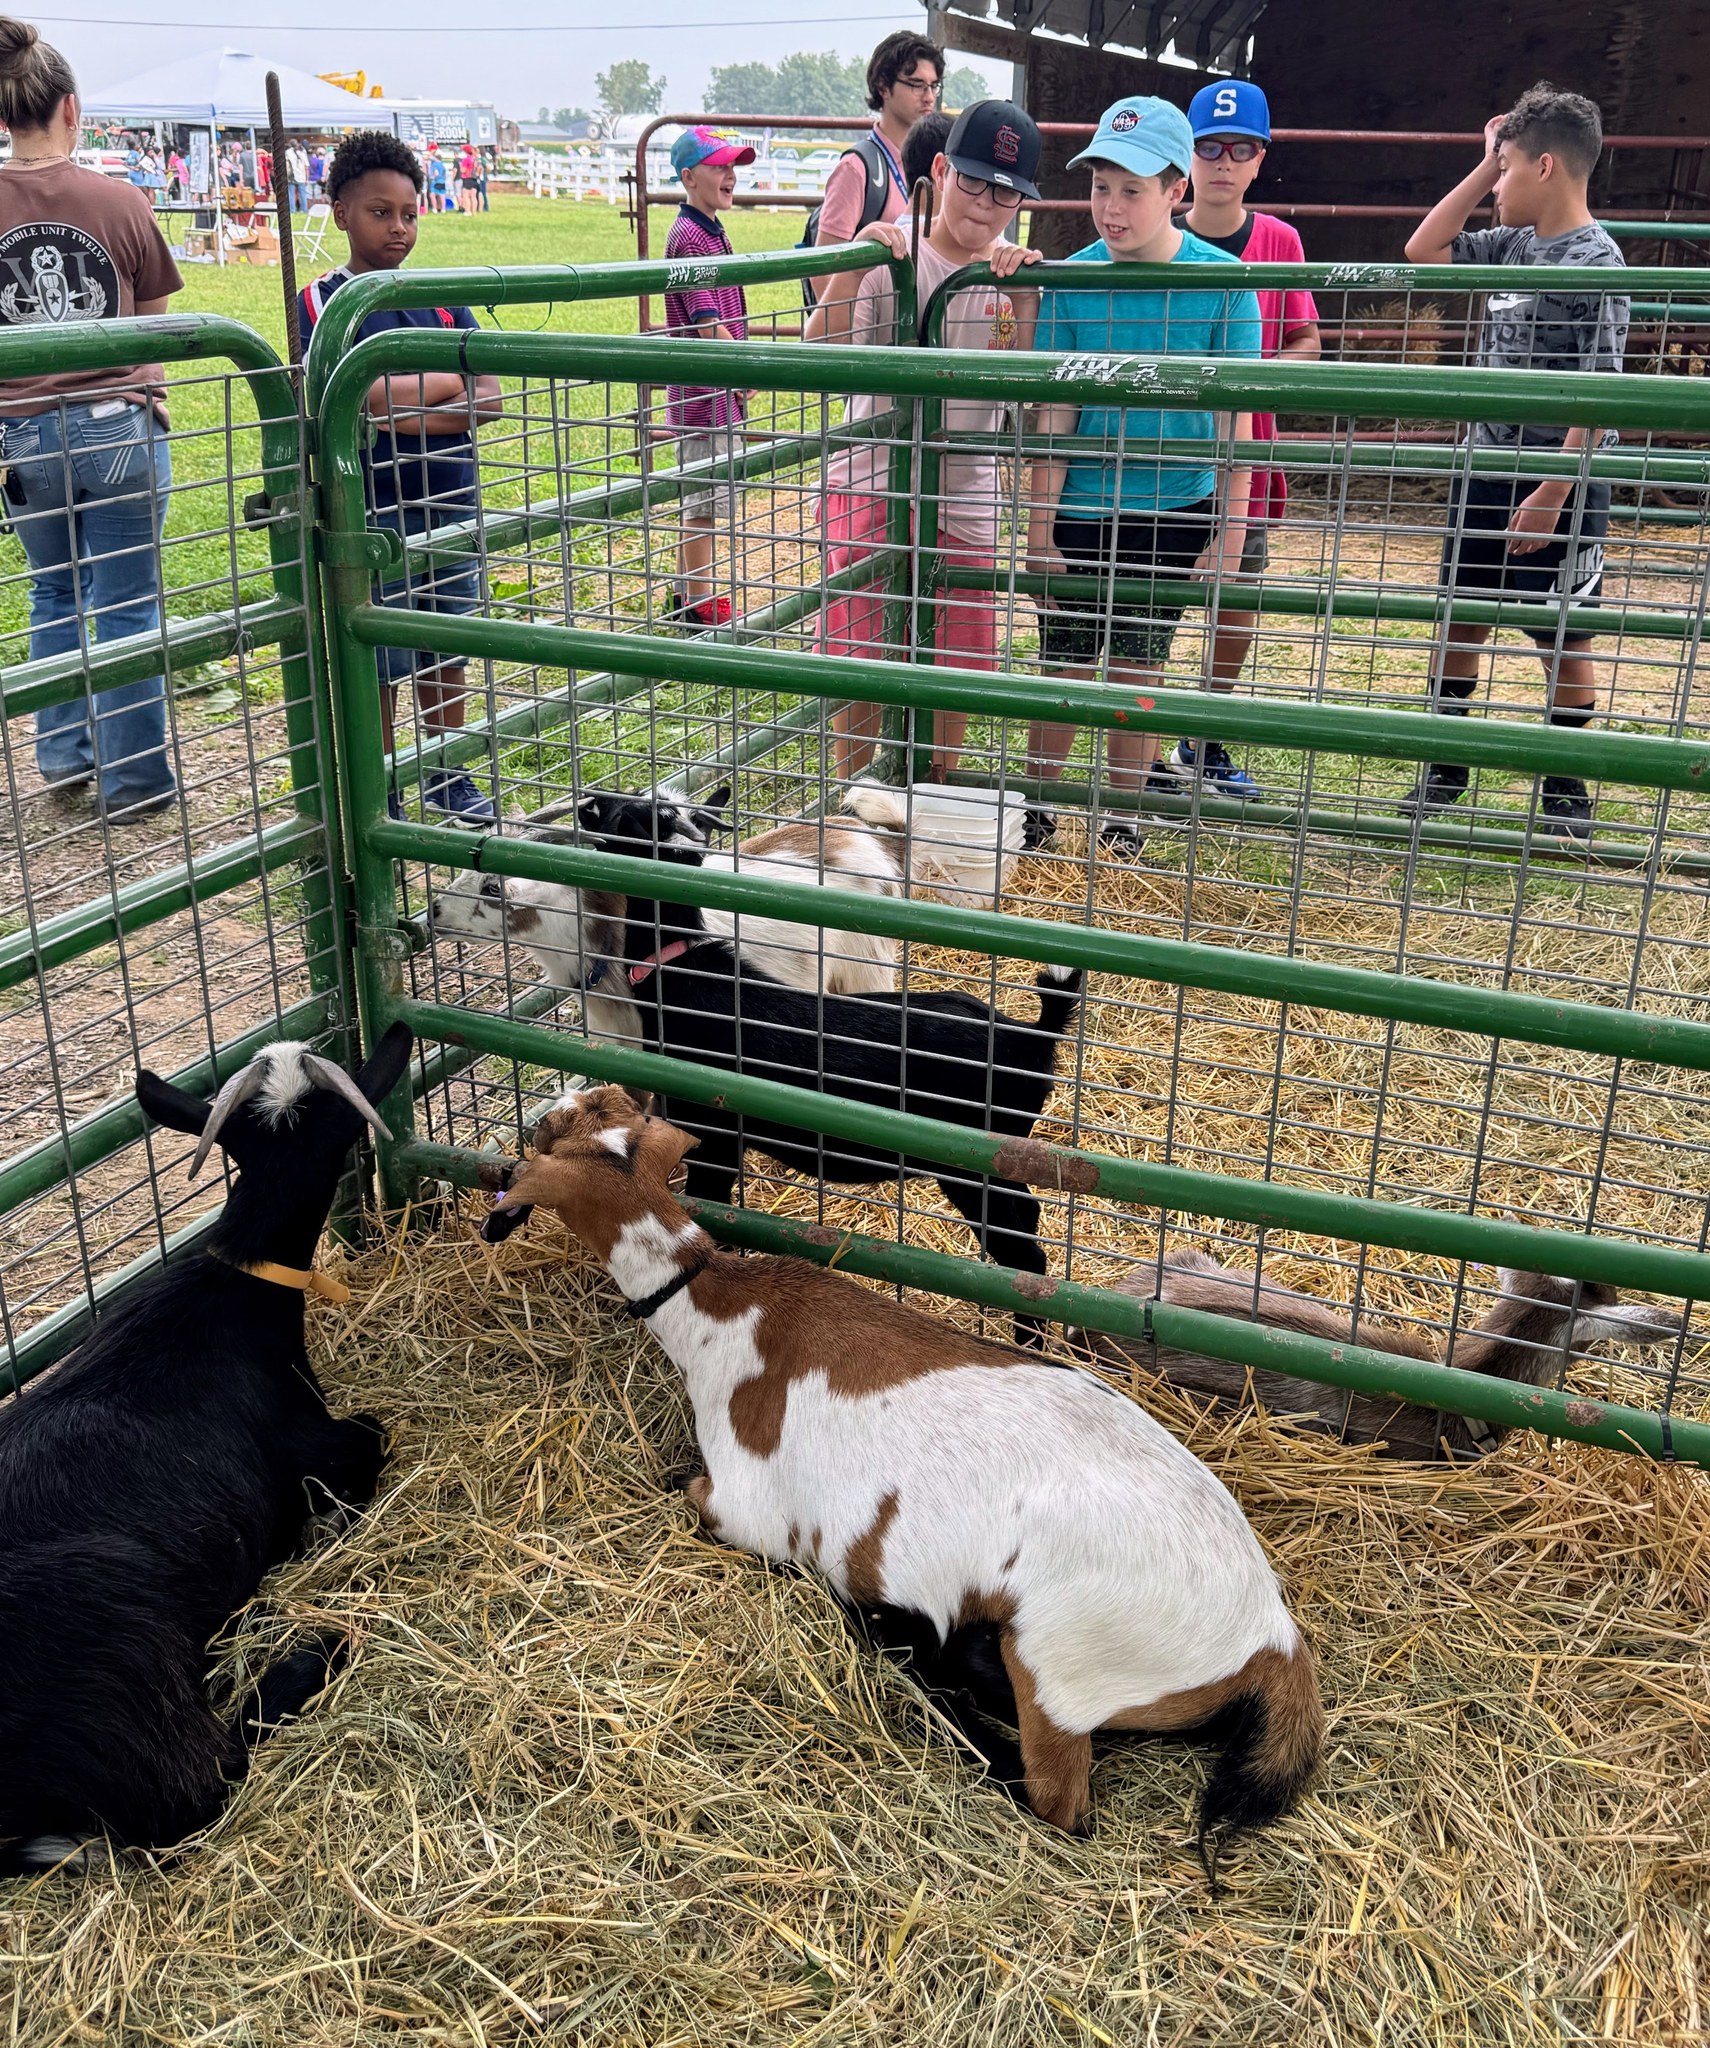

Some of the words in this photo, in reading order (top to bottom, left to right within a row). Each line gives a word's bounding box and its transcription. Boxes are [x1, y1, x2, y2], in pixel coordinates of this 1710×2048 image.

[1213, 89, 1237, 117] S
[1111, 114, 1137, 131] NASA
[0, 227, 38, 252] MOBILE
[41, 226, 67, 236] UNIT
[71, 230, 108, 265] TWELVE
